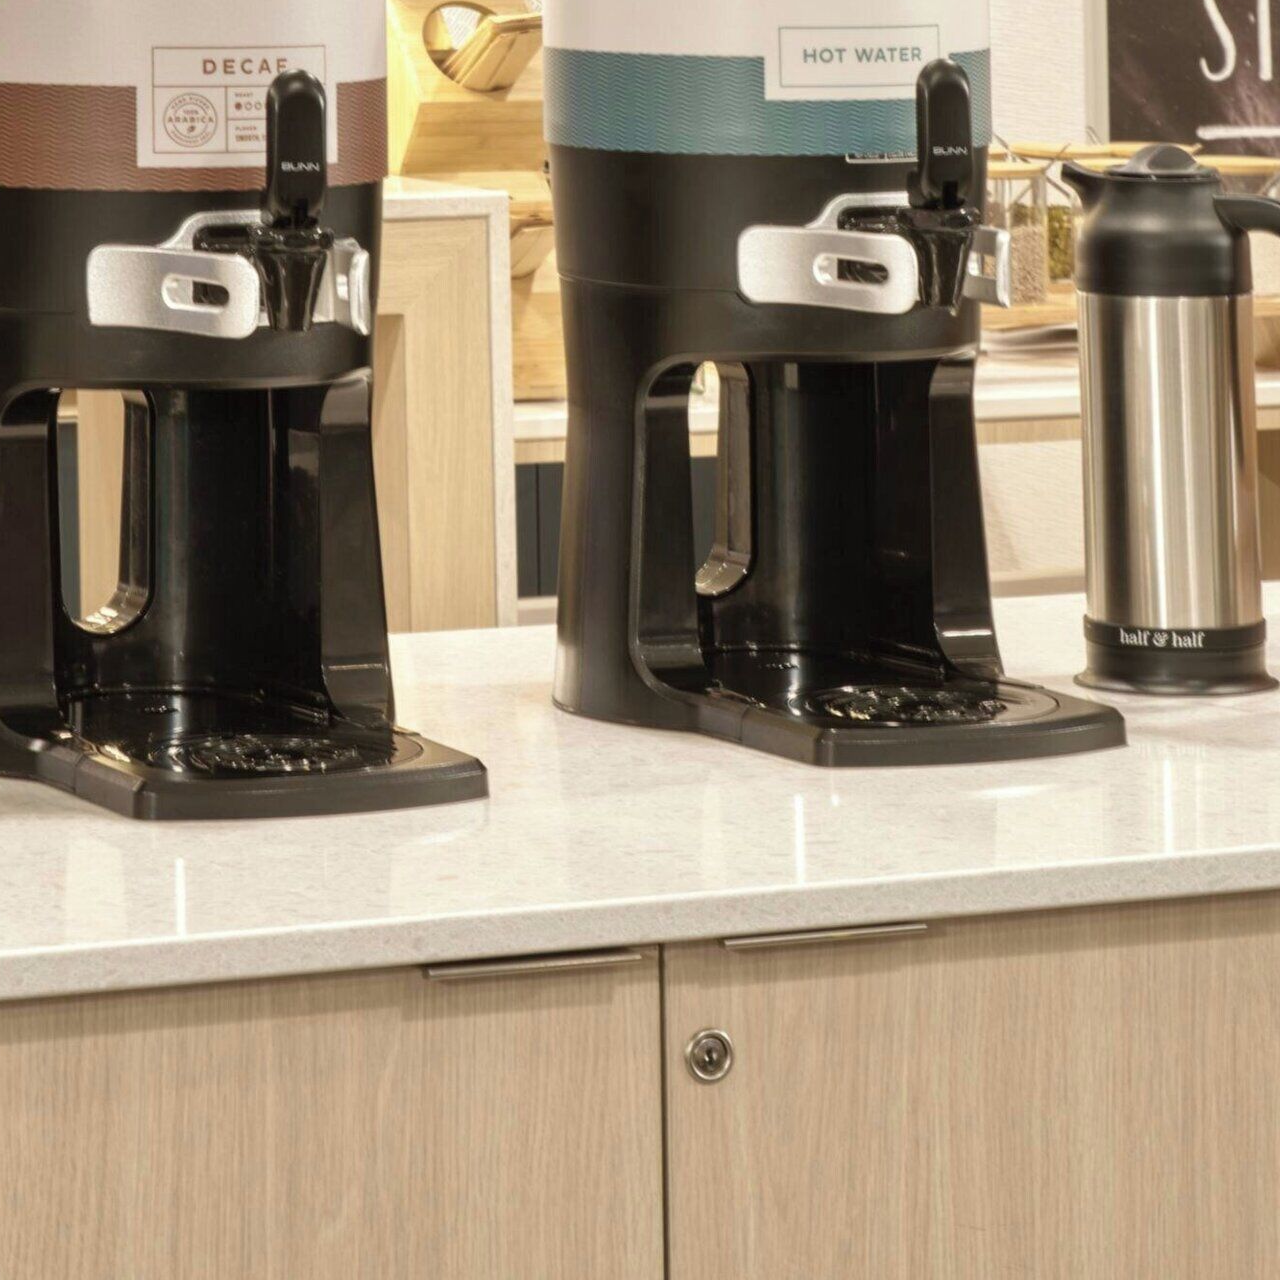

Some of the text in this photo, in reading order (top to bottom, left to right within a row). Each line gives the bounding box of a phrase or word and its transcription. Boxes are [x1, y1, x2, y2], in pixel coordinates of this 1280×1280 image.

[803, 46, 922, 64] HOT WATER
[202, 58, 288, 75] DECAF
[168, 116, 214, 124] ARABICA
[932, 145, 968, 156] BUNN
[281, 161, 320, 172] BUNN
[1119, 626, 1206, 649] half & half
